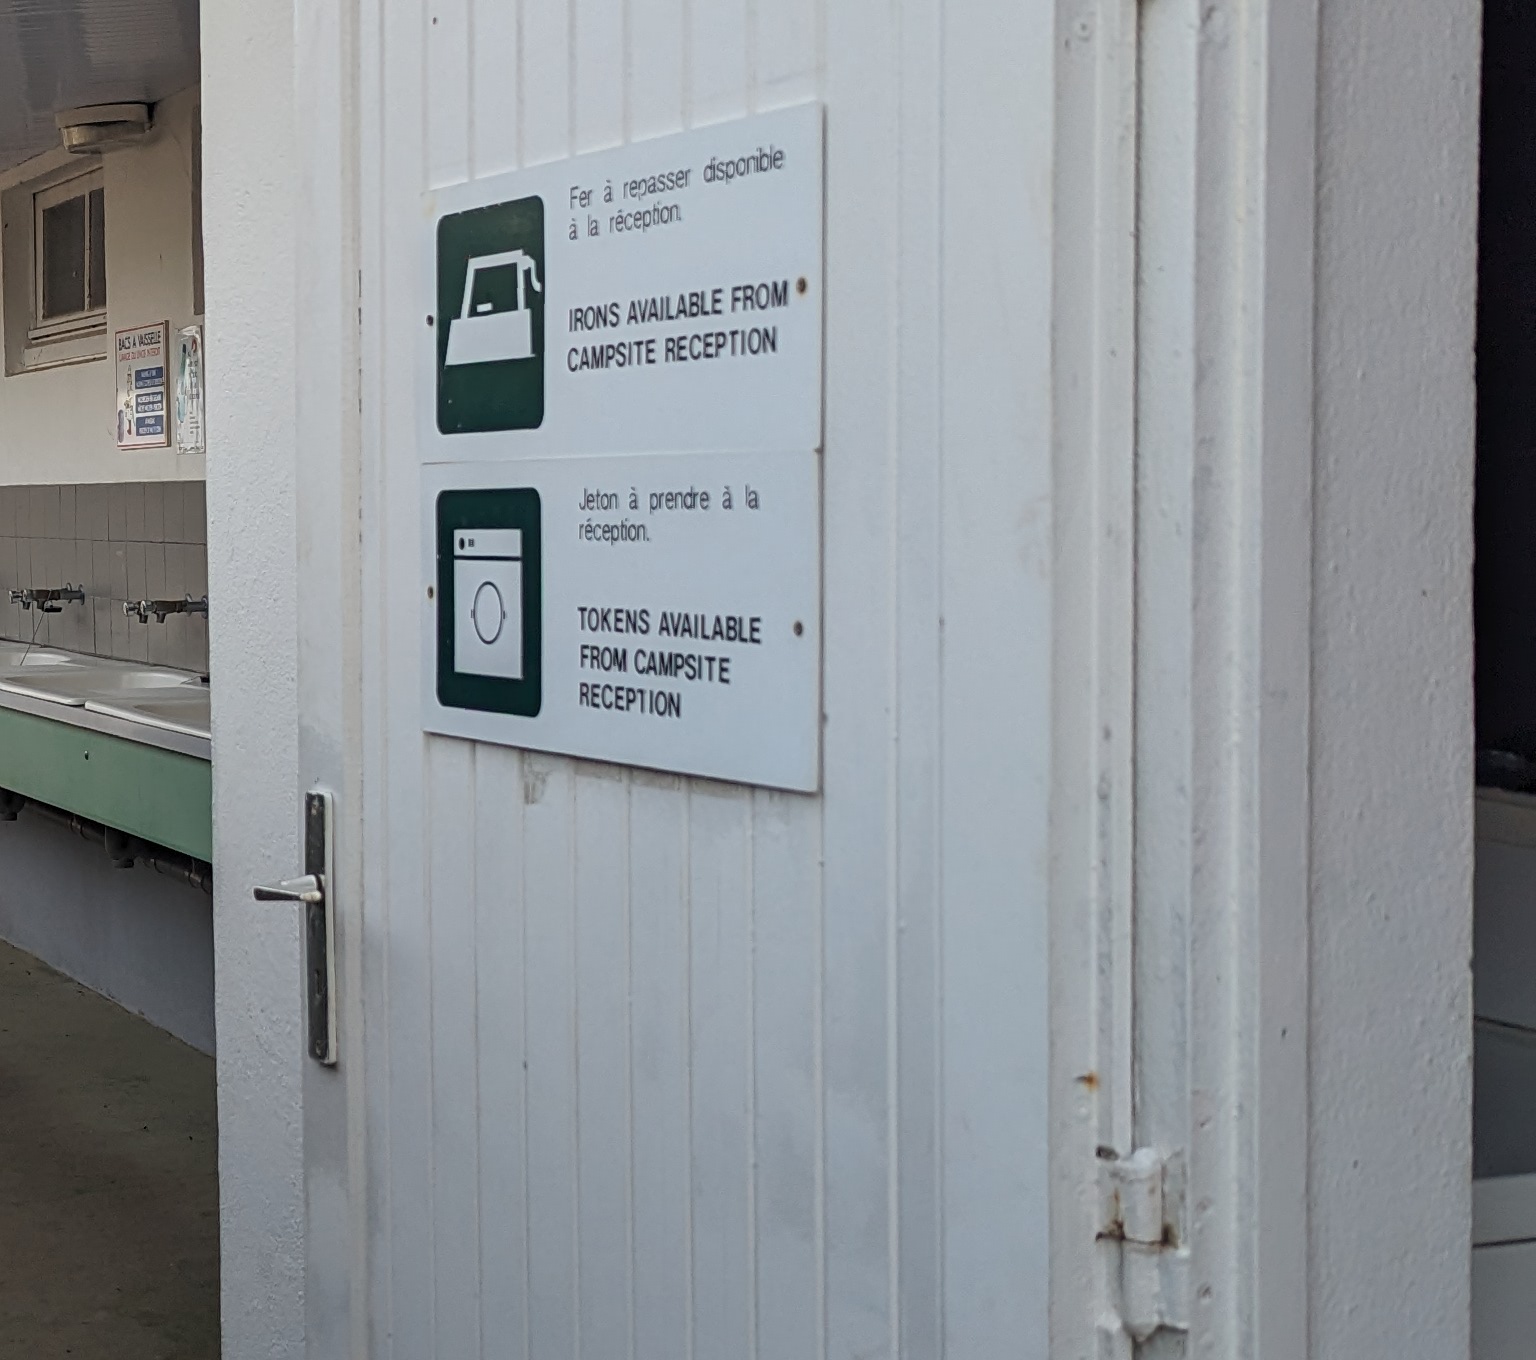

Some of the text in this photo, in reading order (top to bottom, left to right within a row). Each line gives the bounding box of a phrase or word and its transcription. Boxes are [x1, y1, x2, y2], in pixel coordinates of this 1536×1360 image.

[569, 144, 785, 209] Fer à repasser disponible
[568, 218, 578, 241] à
[588, 213, 599, 237] la
[568, 279, 788, 332] IRONS AVAILABLE FROM
[567, 325, 777, 372] CAMPSITE RECEPTION
[578, 485, 760, 514] Jeton à prendre à la
[578, 518, 651, 546] réception.
[577, 606, 762, 644] TOKENS AVAILABLE
[579, 644, 731, 684] FROM CAMPSITE
[579, 682, 681, 718] RECEPTION
